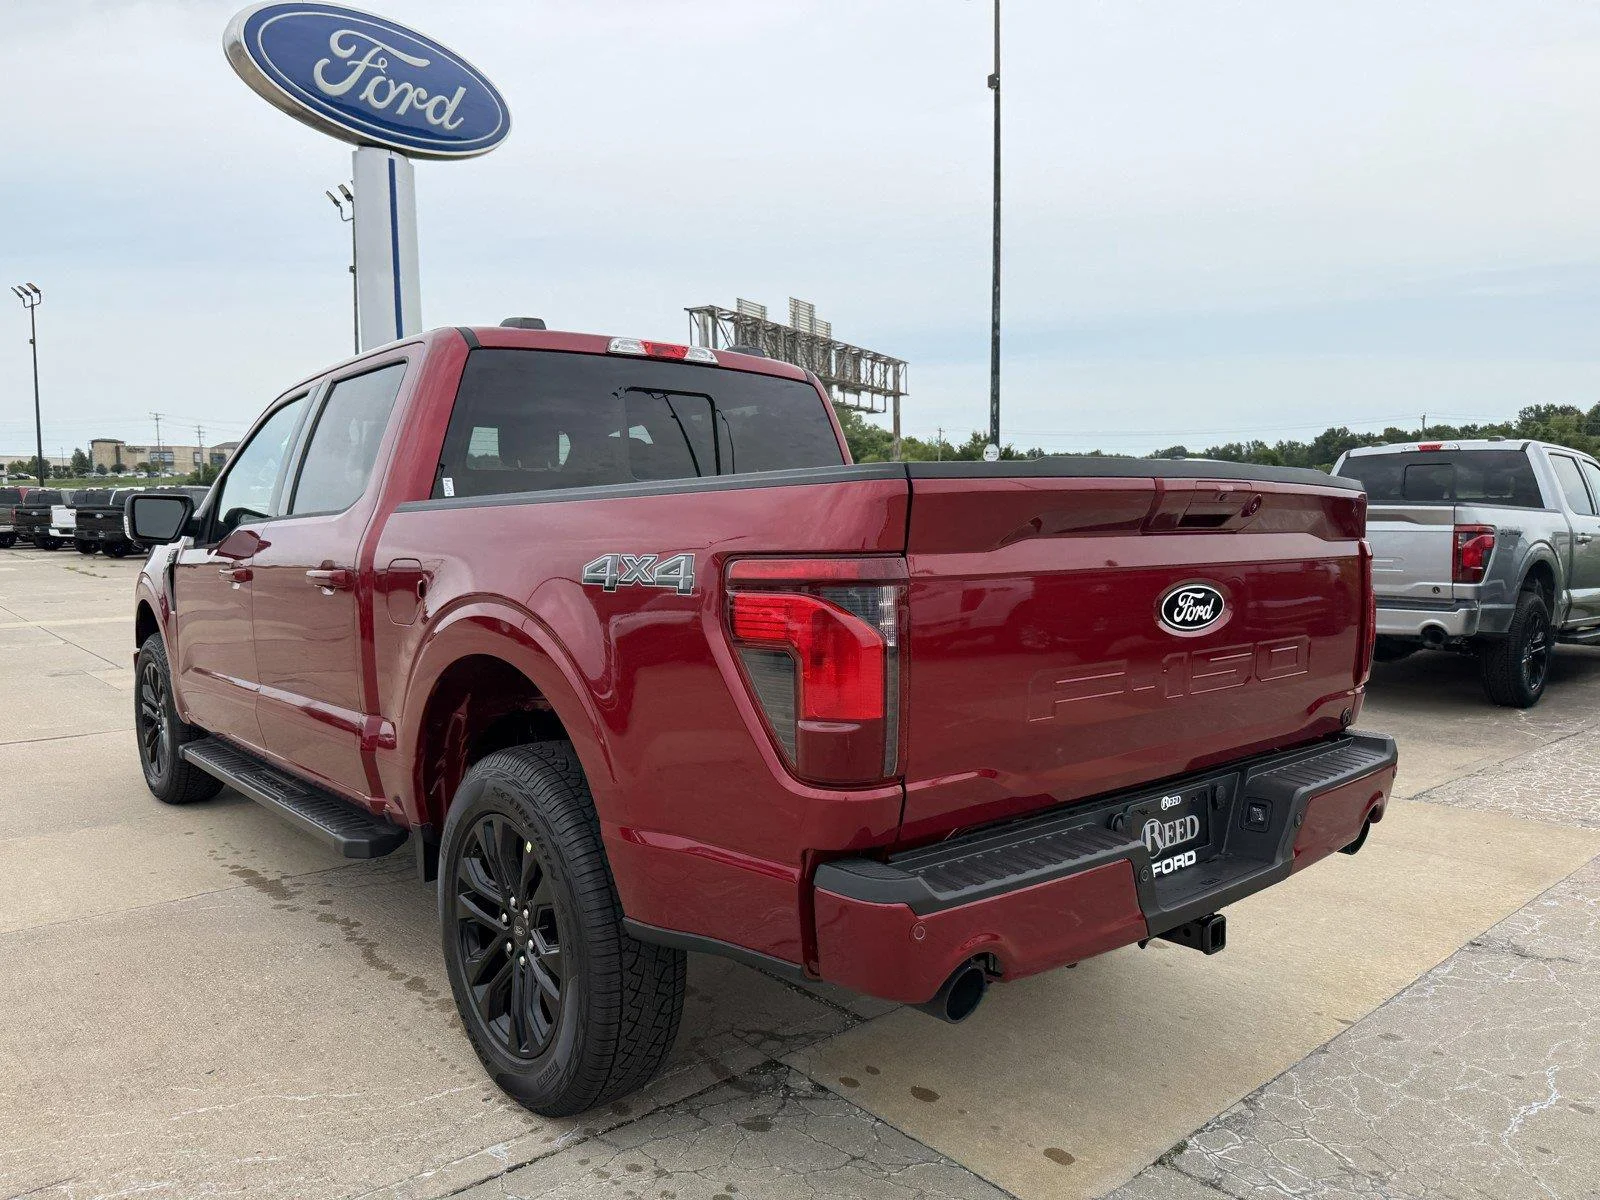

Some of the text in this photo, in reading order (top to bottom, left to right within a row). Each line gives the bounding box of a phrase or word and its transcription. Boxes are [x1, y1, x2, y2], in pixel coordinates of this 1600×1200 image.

[313, 29, 467, 130] Ford
[1173, 592, 1215, 623] Ford
[1028, 634, 1311, 722] F-150
[1161, 795, 1182, 811] REED
[1142, 814, 1200, 857] REED
[1152, 850, 1197, 878] FORD
